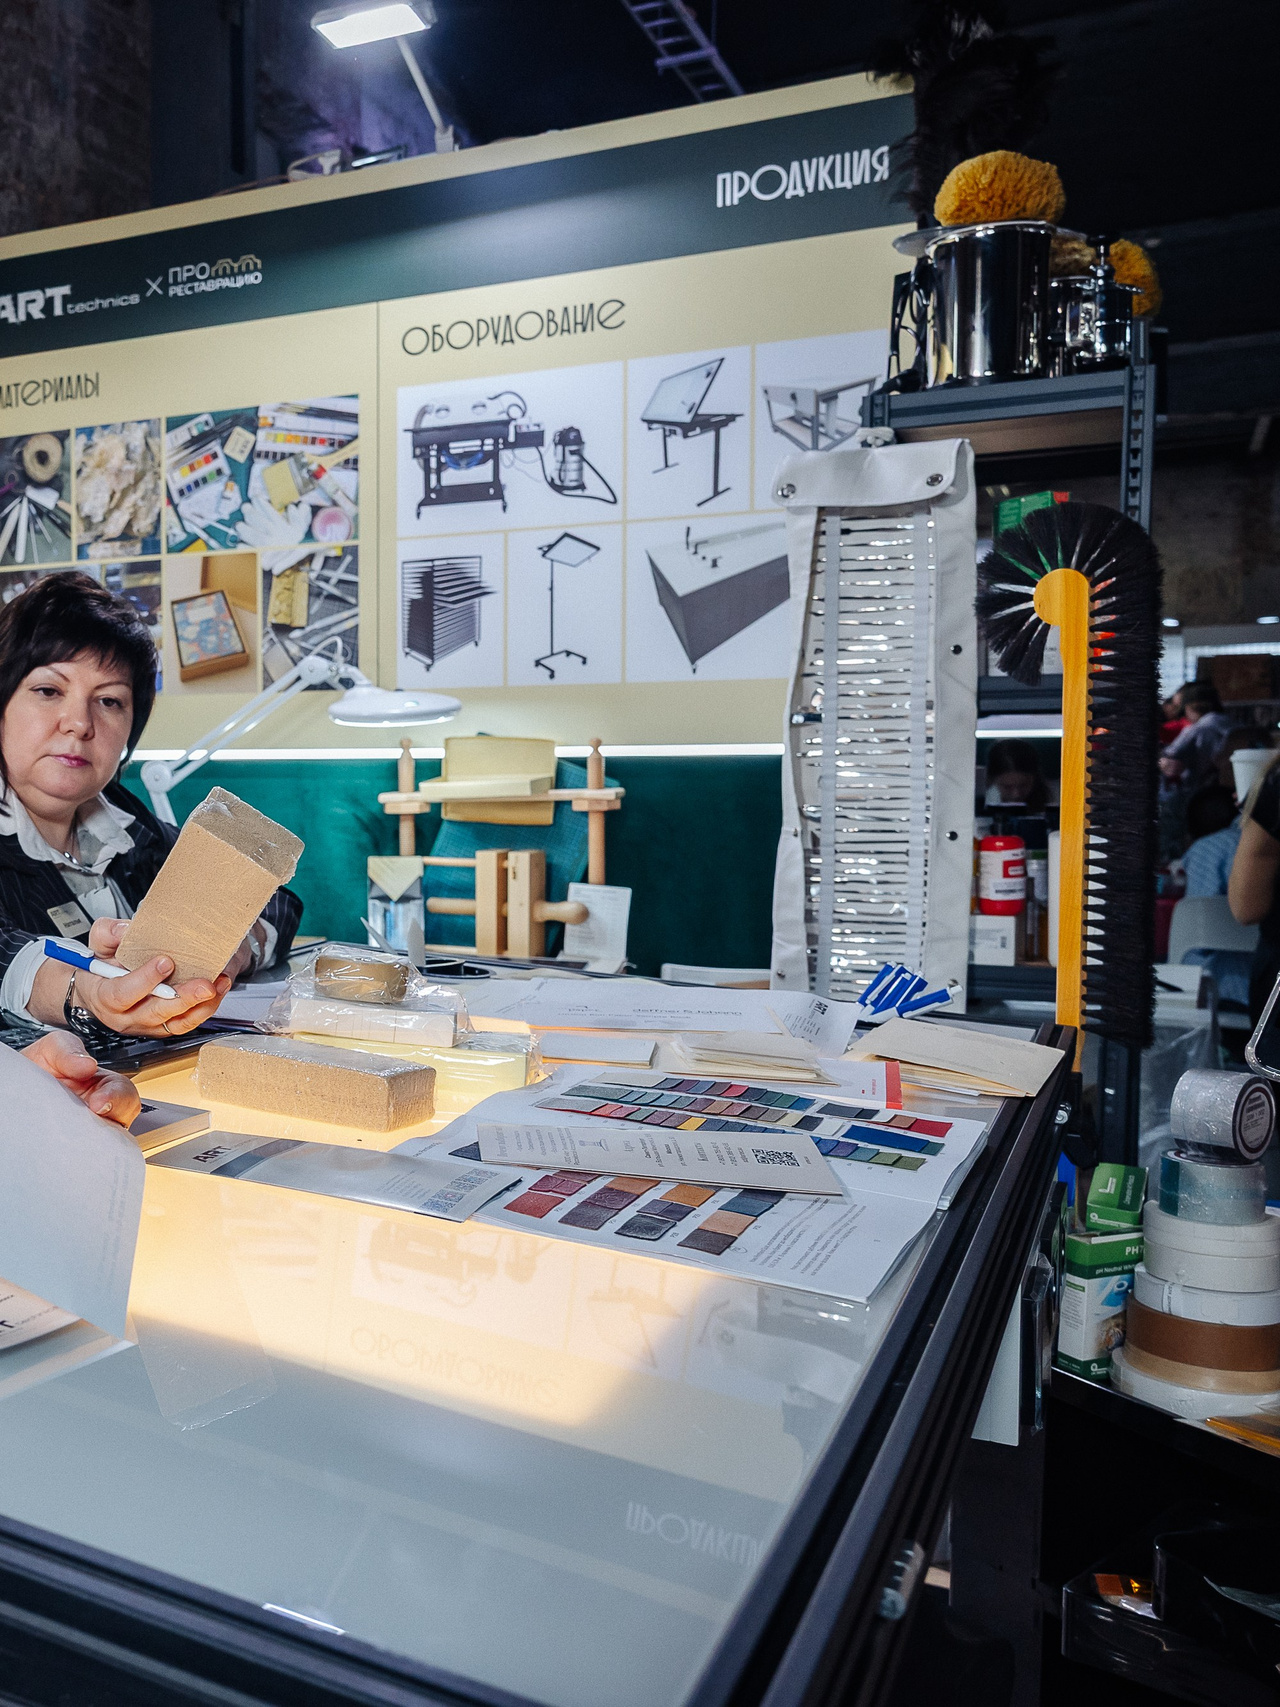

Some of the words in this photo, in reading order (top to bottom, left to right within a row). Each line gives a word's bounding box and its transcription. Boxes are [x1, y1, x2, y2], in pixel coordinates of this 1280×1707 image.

[716, 145, 890, 208] ПРОДУКЦИЯ
[169, 262, 211, 284] ПРО
[169, 271, 263, 297] РЕСТАВРАЦИЮ
[66, 292, 141, 315] technics
[192, 1146, 231, 1163] ART
